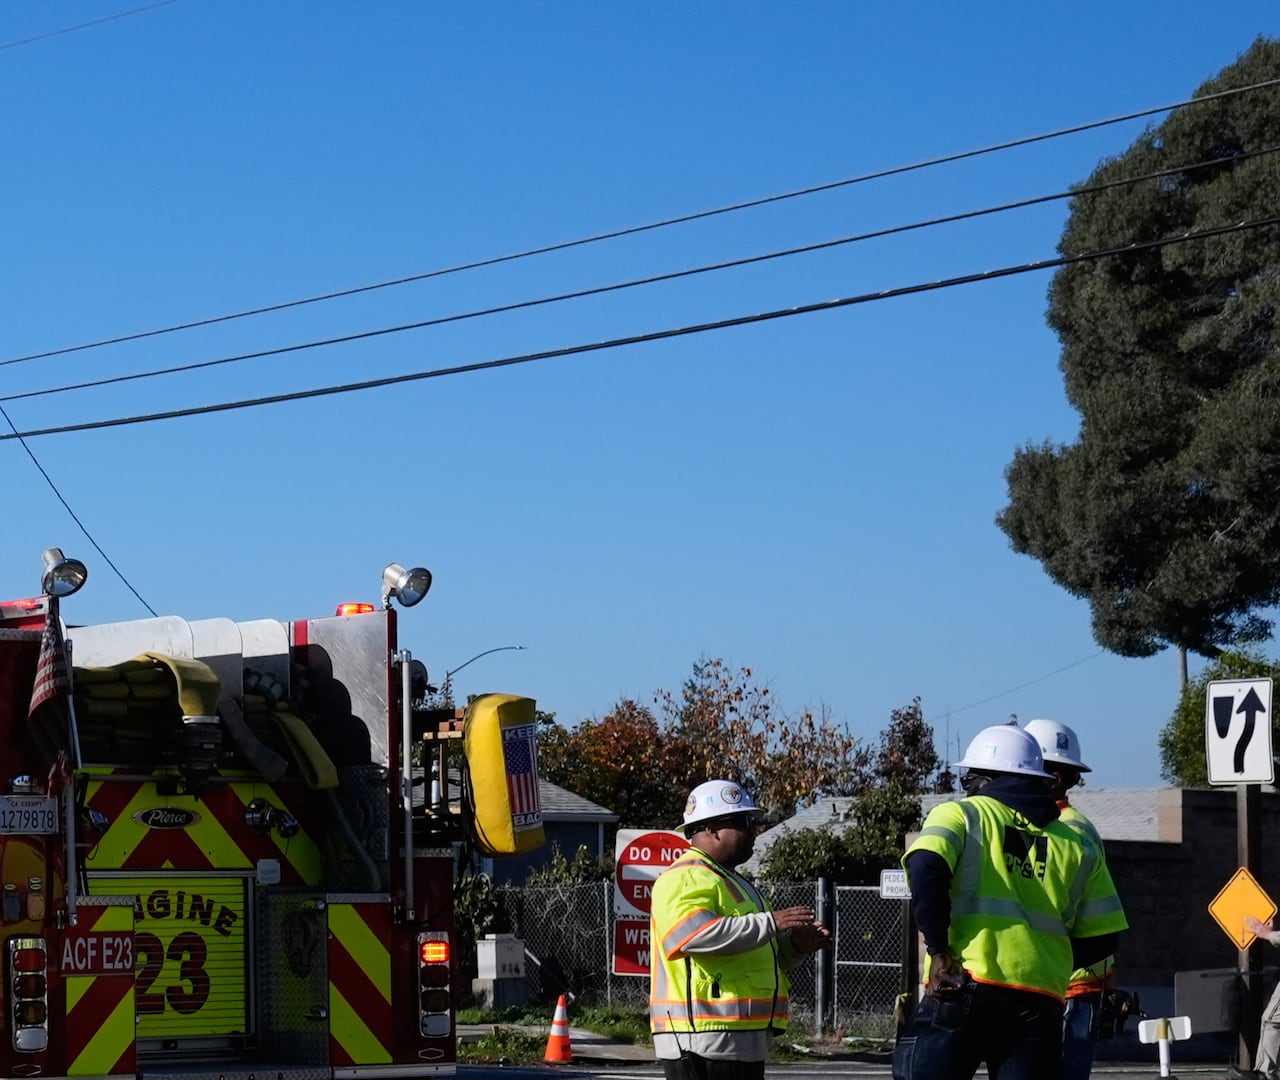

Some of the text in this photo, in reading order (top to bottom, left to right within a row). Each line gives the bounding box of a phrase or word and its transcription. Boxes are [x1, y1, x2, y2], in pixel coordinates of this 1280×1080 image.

[504, 727, 536, 741] KEE
[1, 810, 54, 829] 1279878
[147, 810, 188, 826] Pierce
[513, 812, 541, 827] BAC
[629, 847, 651, 861] DO
[884, 874, 905, 882] PEDES
[135, 889, 238, 937] GINE
[61, 937, 133, 970] ACF E23
[135, 932, 210, 1014] 23
